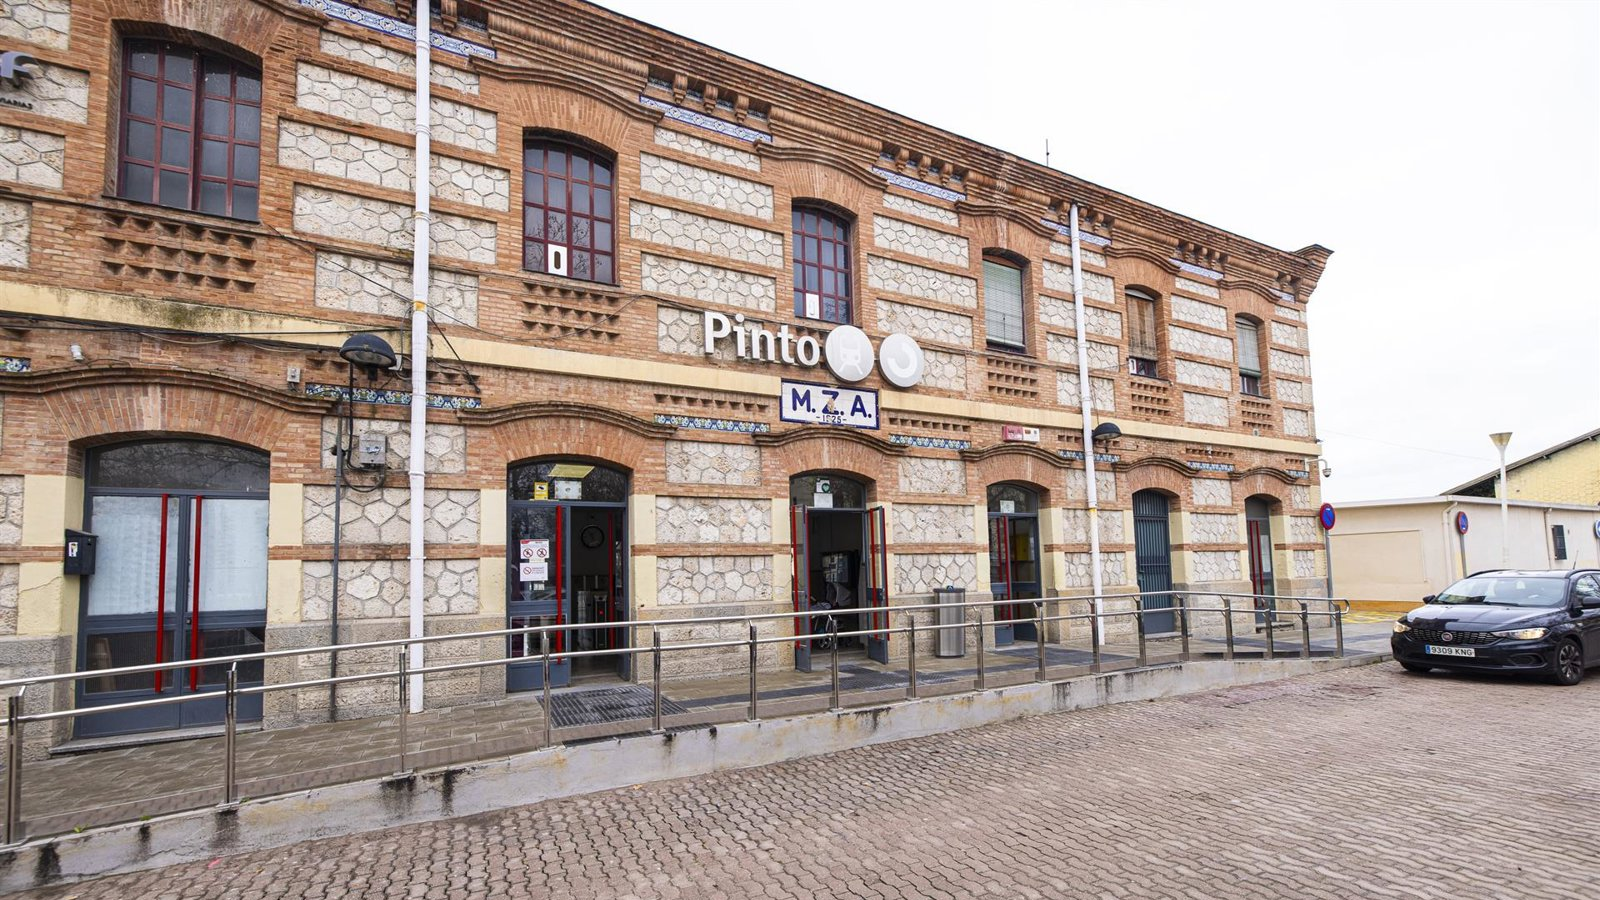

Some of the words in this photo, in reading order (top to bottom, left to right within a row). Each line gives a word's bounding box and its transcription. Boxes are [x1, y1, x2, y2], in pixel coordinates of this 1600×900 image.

[704, 311, 821, 367] Pinto
[1431, 646, 1453, 655] 9309
[1454, 648, 1473, 656] KNG
